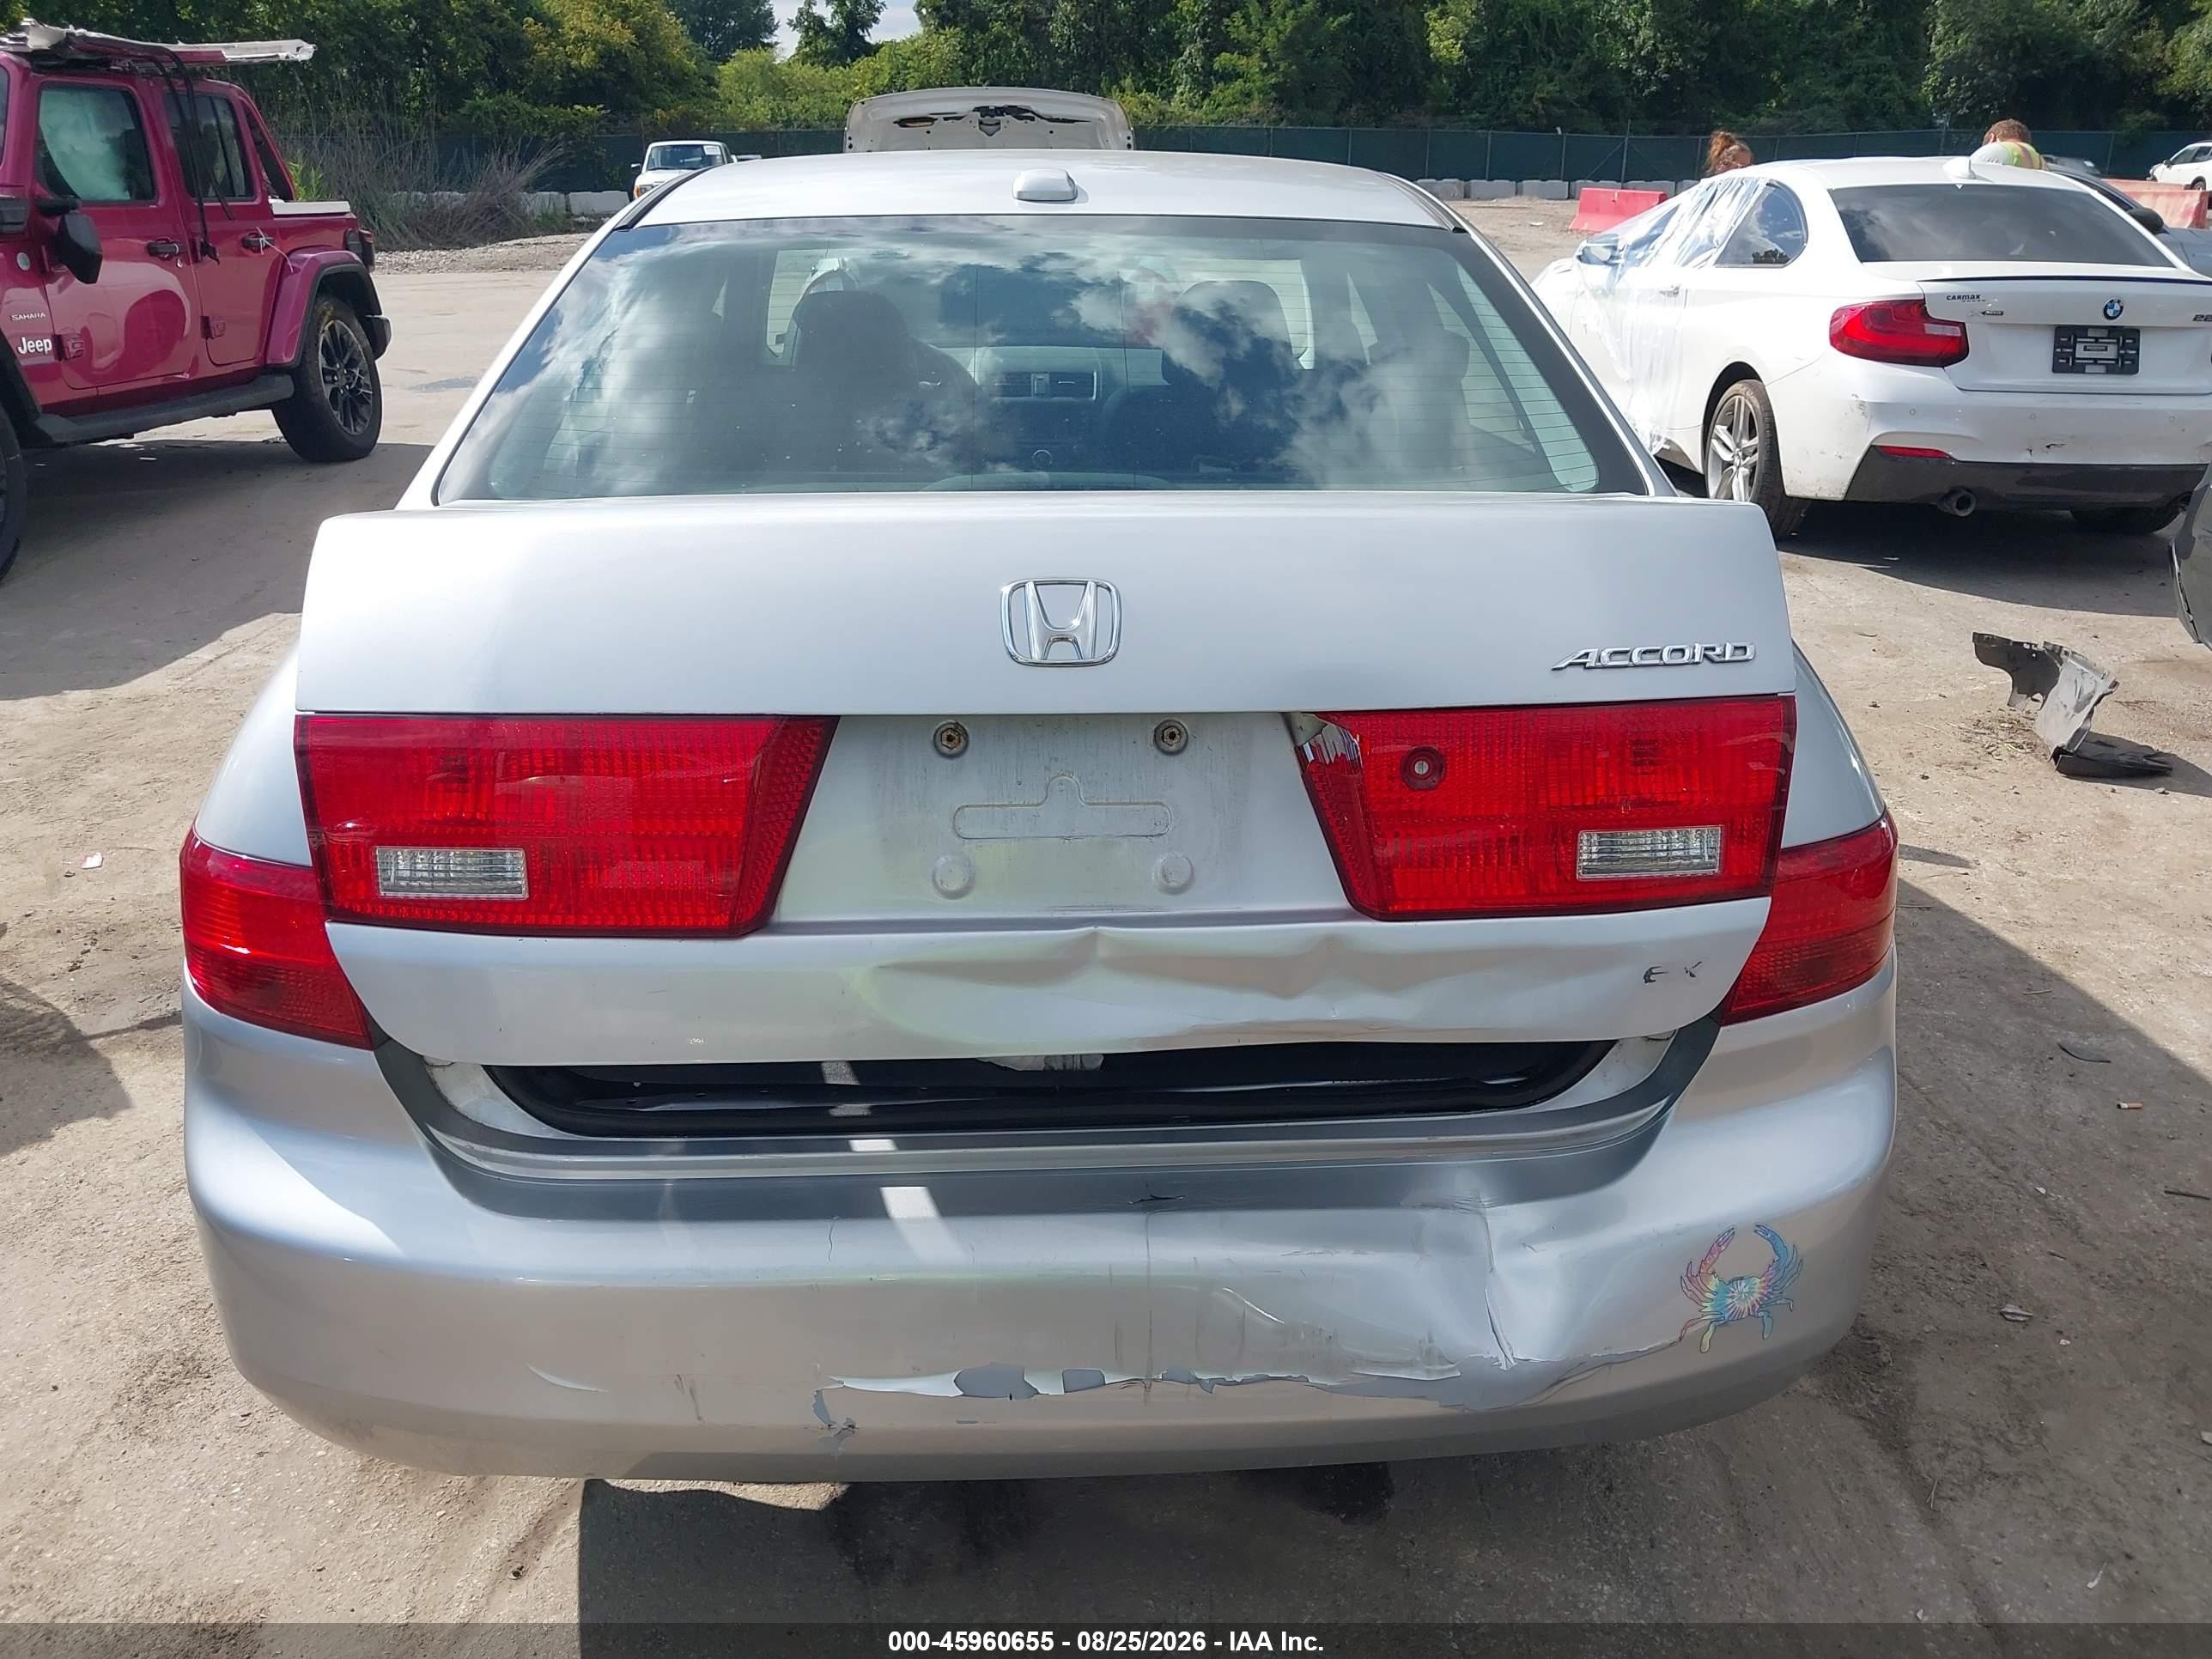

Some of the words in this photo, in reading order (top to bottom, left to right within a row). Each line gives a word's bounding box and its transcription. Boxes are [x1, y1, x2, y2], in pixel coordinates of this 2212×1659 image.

[11, 312, 46, 321] SAHARA
[17, 337, 52, 355] Jeep
[1551, 642, 1757, 672] ACCORD
